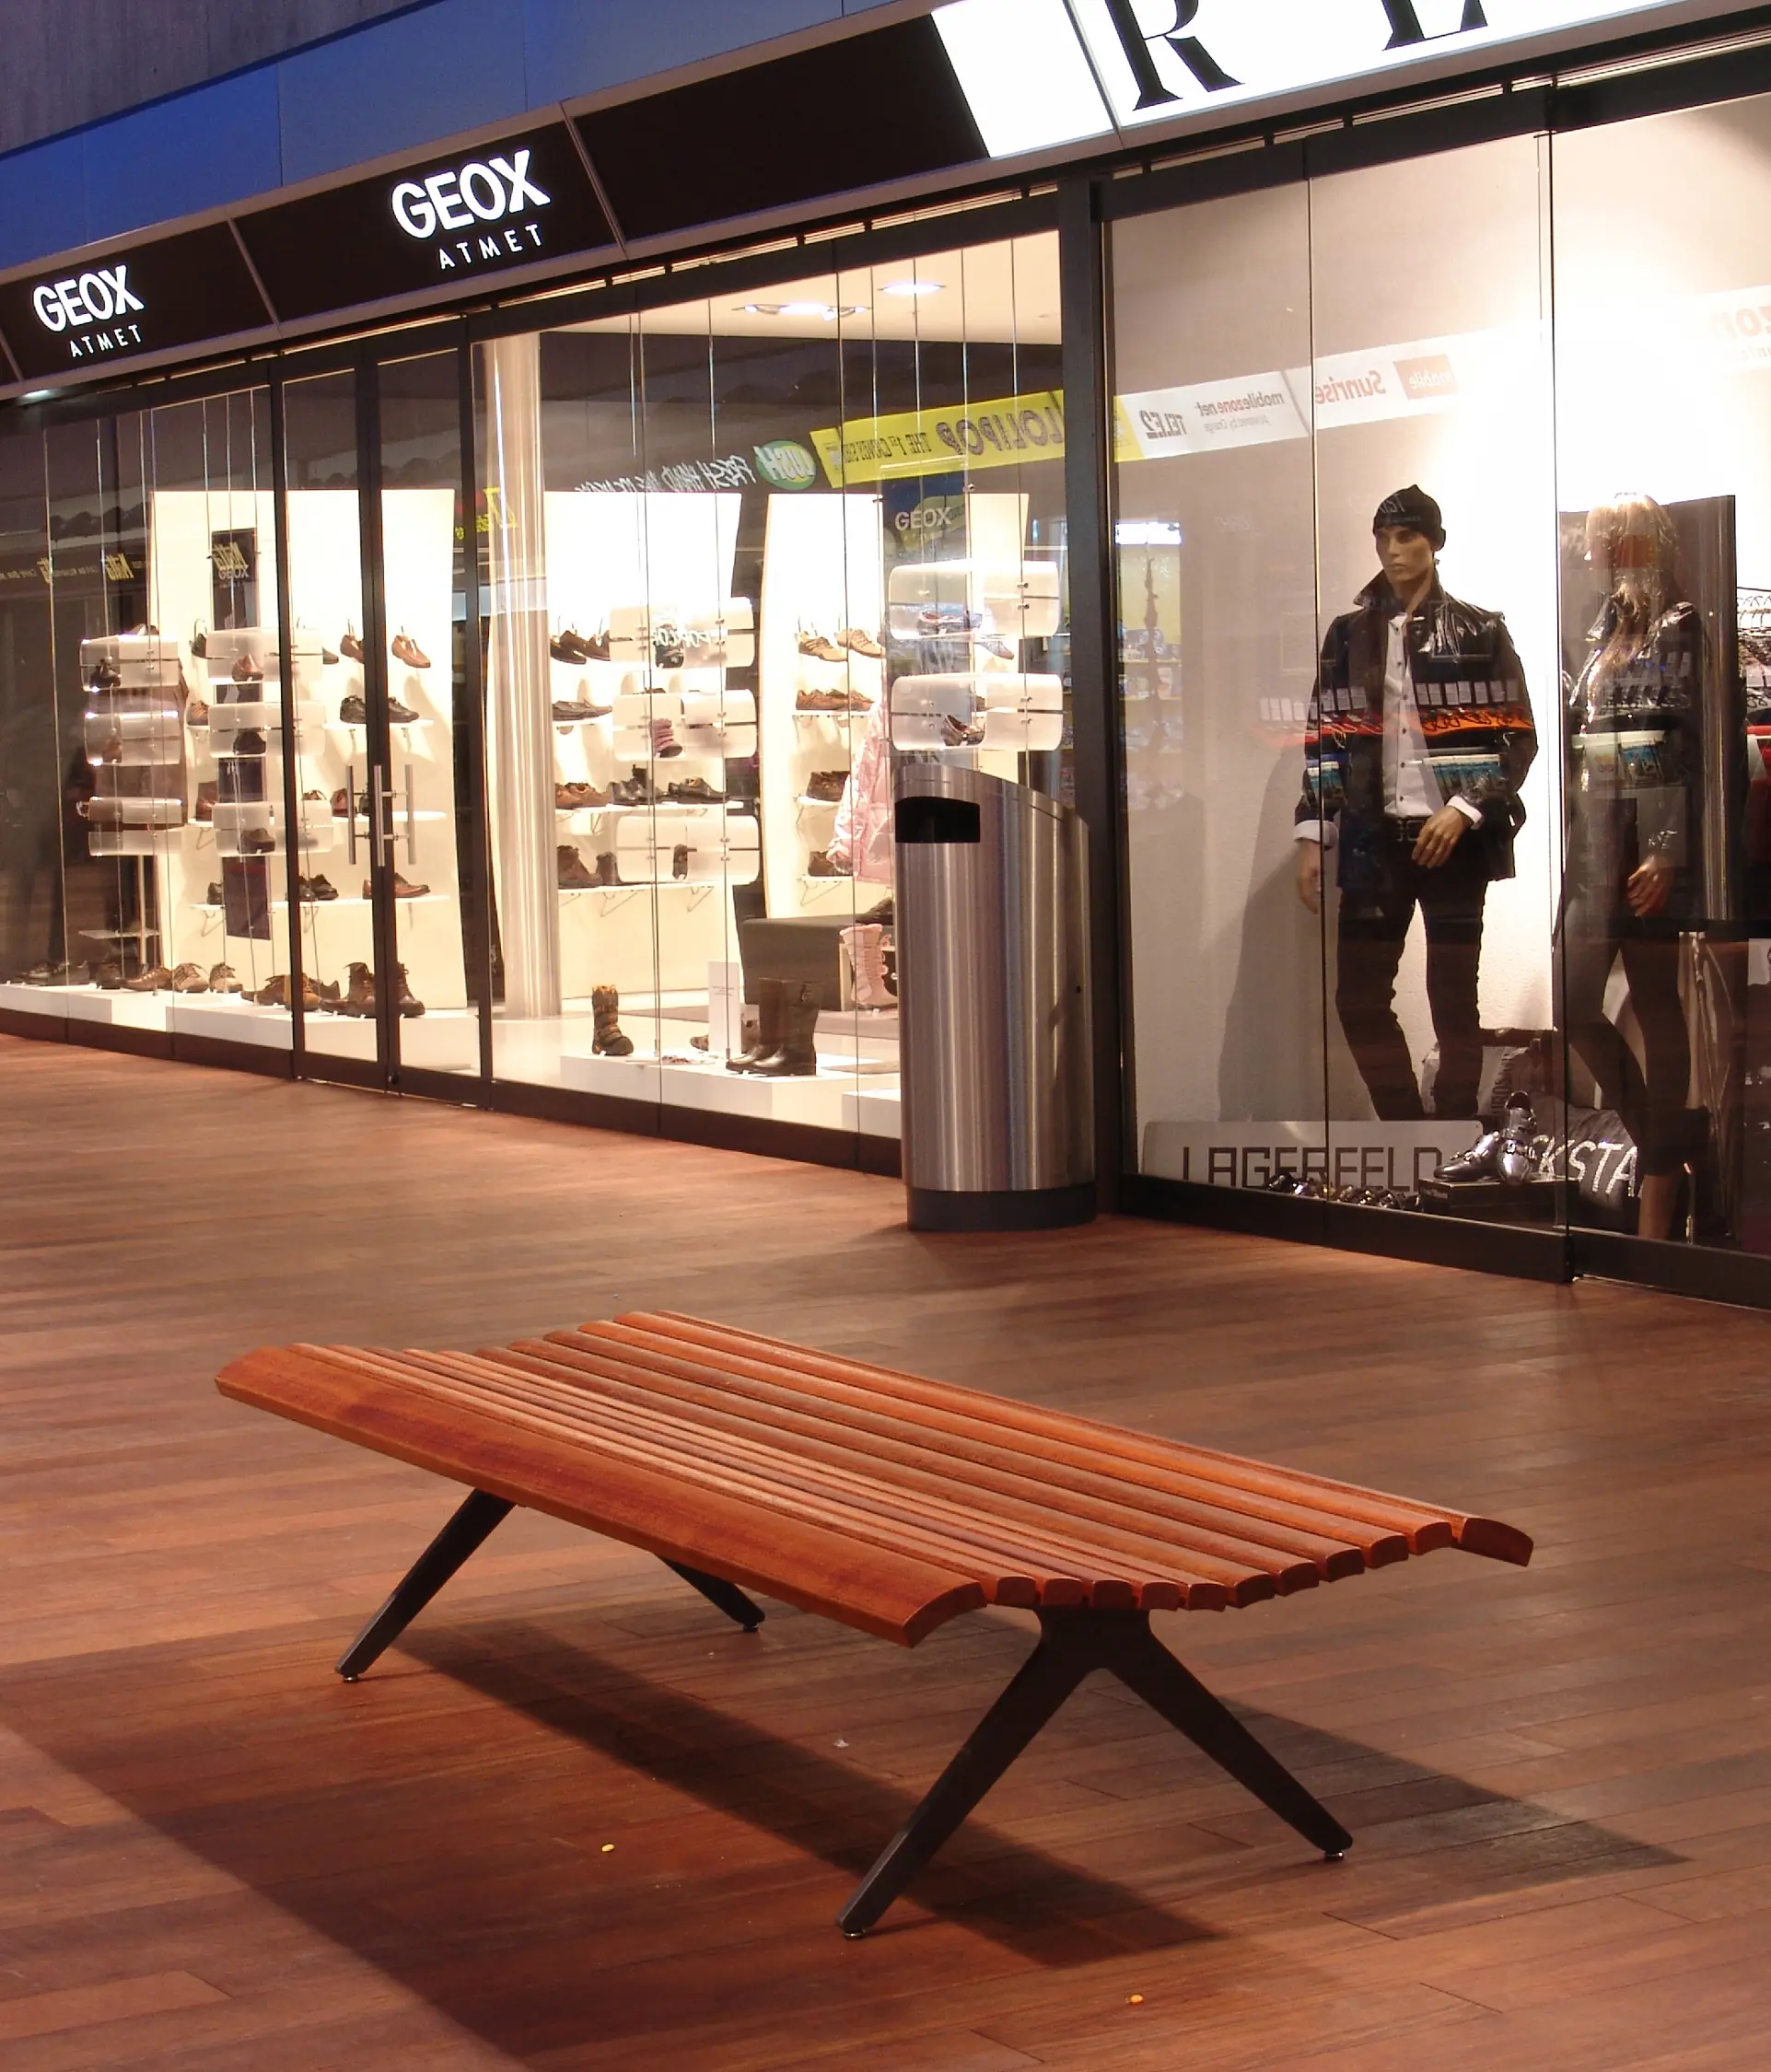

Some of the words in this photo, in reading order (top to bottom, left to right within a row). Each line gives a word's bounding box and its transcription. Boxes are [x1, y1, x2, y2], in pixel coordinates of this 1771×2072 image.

[391, 149, 551, 239] GEOX
[438, 224, 542, 270] ATMET
[33, 264, 145, 332] GEOX
[69, 324, 142, 358] ATMET
[894, 506, 952, 531] GEOX
